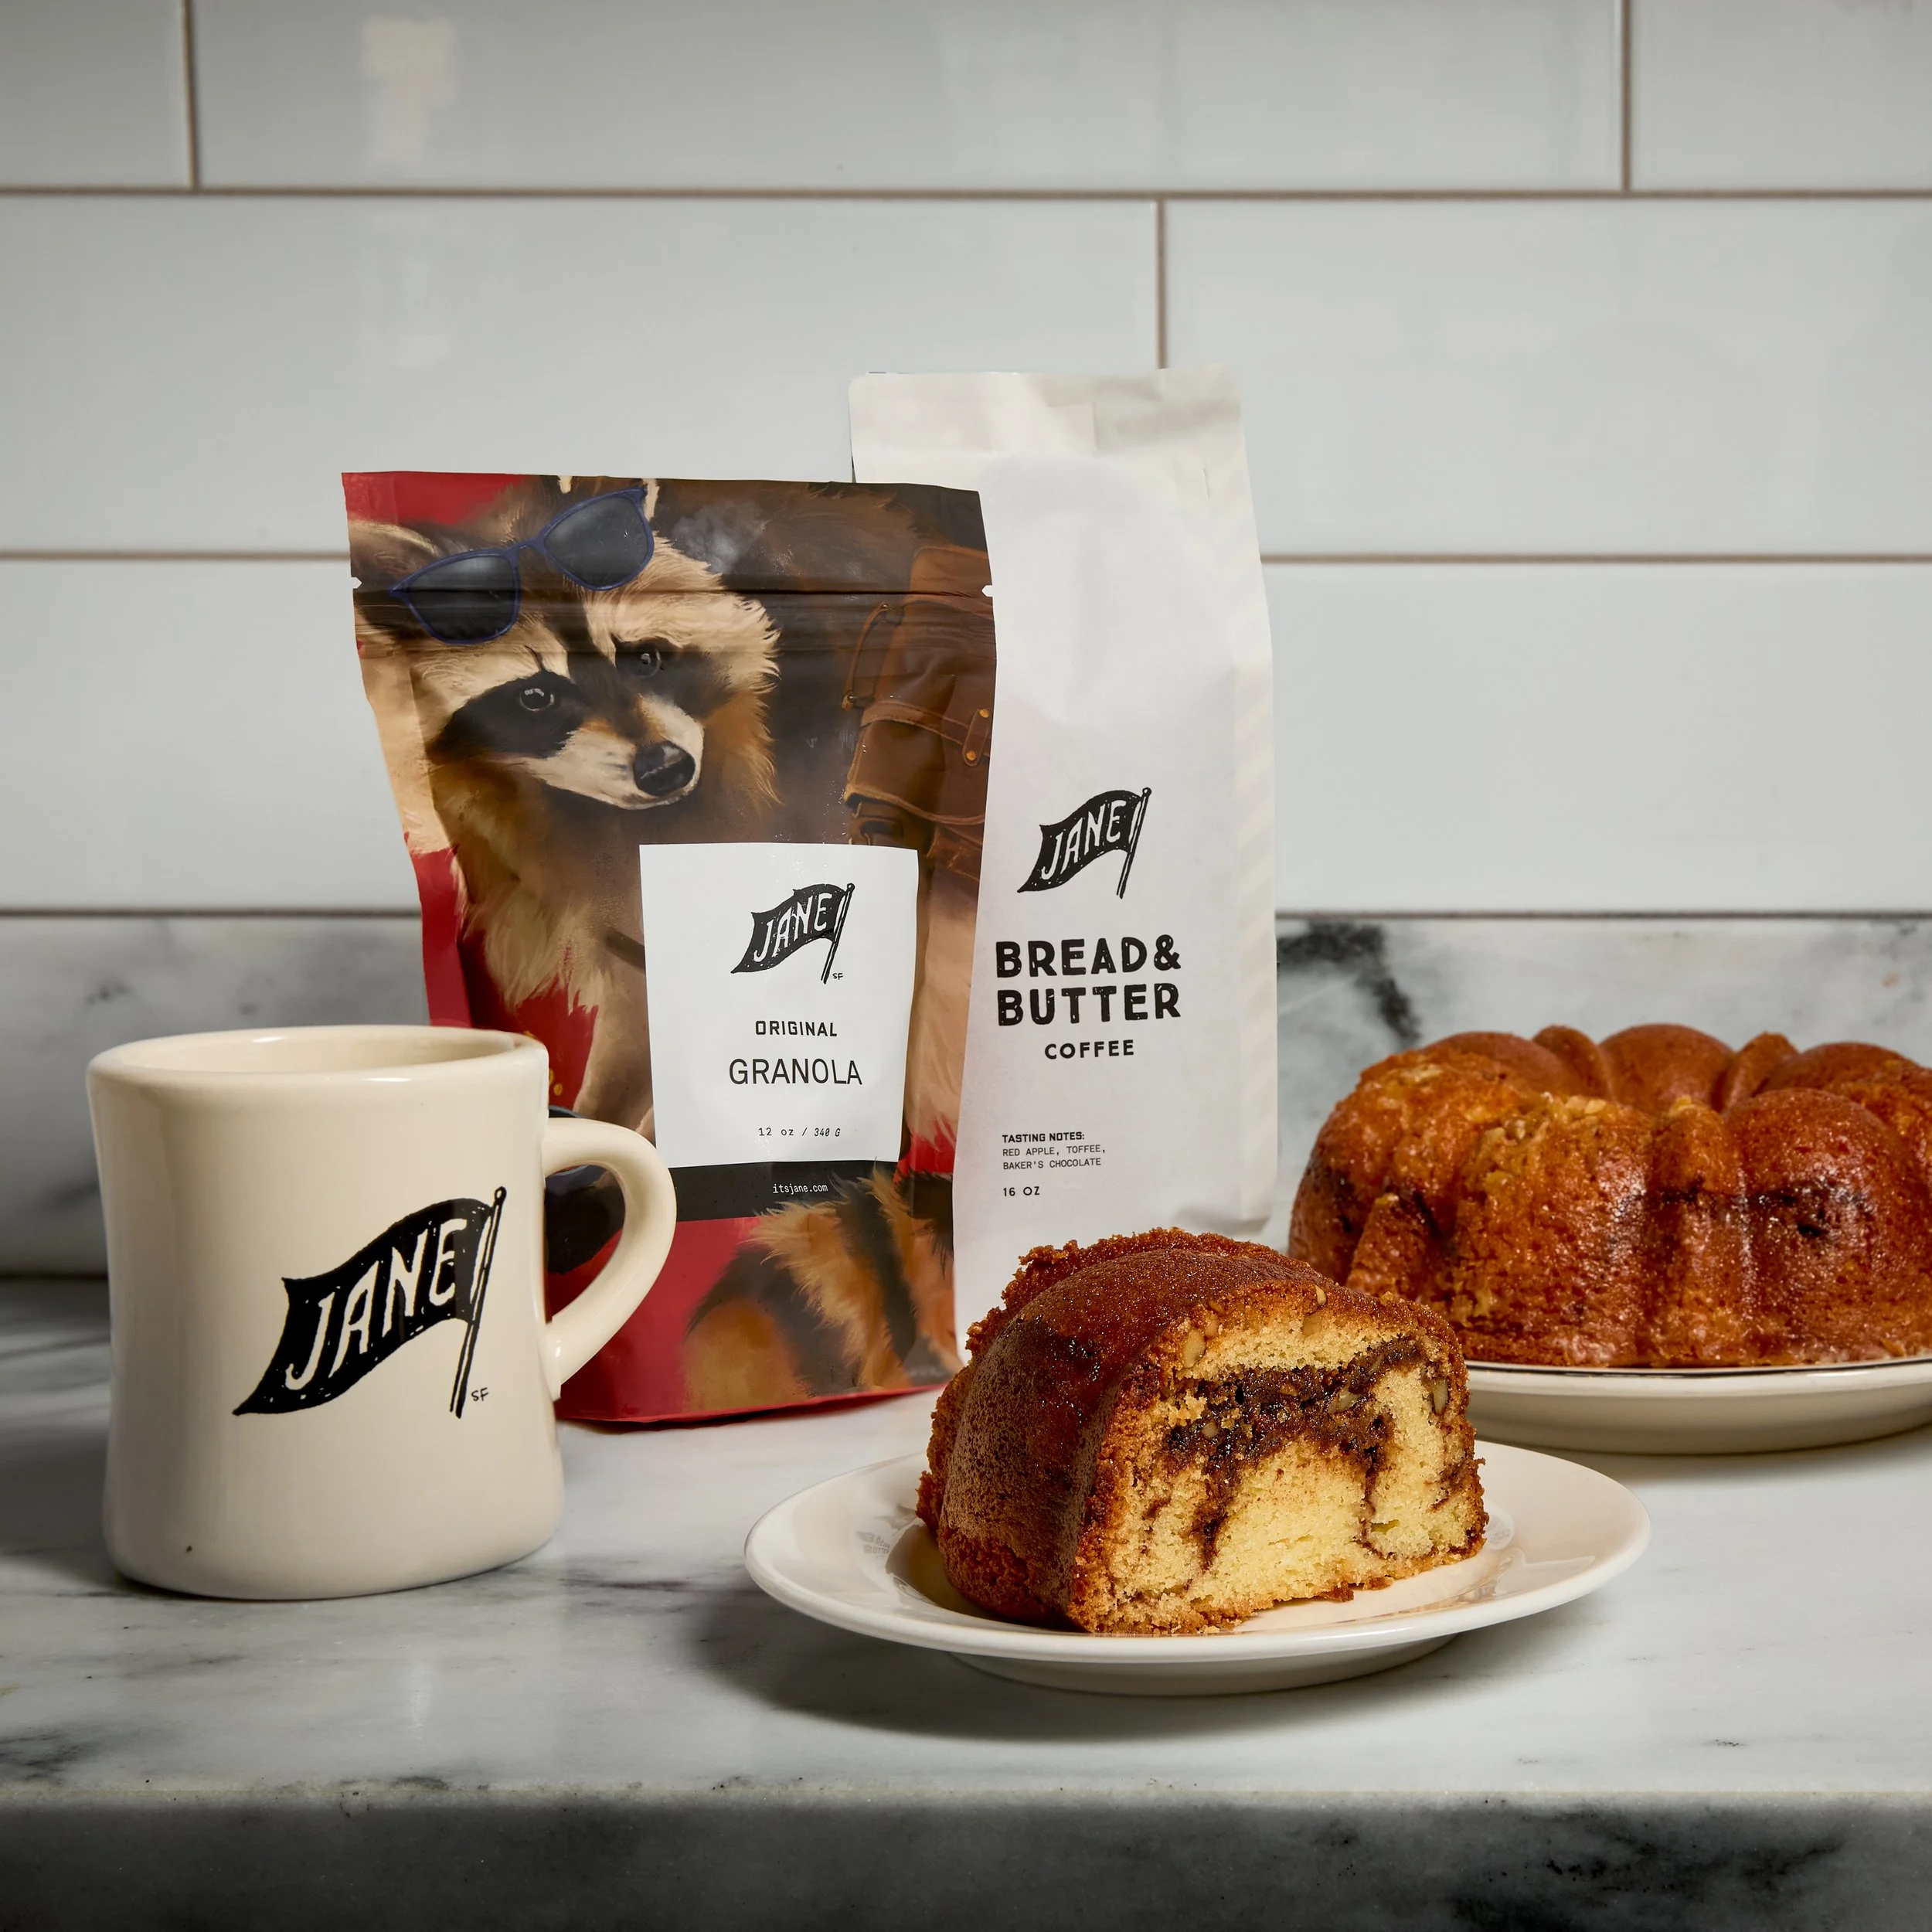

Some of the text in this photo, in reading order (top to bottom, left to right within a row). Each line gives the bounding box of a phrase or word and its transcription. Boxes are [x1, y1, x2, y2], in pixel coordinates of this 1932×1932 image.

[1042, 799, 1127, 880] JANE
[753, 892, 833, 963] JANE
[995, 934, 1182, 978] BREAD&
[832, 972, 844, 981] SF
[997, 982, 1182, 1027] BUTTER
[755, 1020, 838, 1037] ORIGINAL
[1044, 1039, 1135, 1060] COFFEE
[729, 1058, 863, 1086] GRANOLA
[758, 1127, 773, 1137] 12
[801, 1127, 808, 1137] /
[814, 1128, 830, 1137] 340
[835, 1128, 841, 1137] G
[1002, 1131, 1085, 1144] TASTING NOTES:
[1002, 1145, 1105, 1157] RED APPLE, TOFFEE,
[1003, 1158, 1101, 1170] BAKER'S CHOCOLATE
[773, 1183, 828, 1196] itsjane.com
[1003, 1186, 1040, 1197] 16 OZ
[284, 1217, 468, 1391] JANE
[471, 1387, 489, 1402] SF
